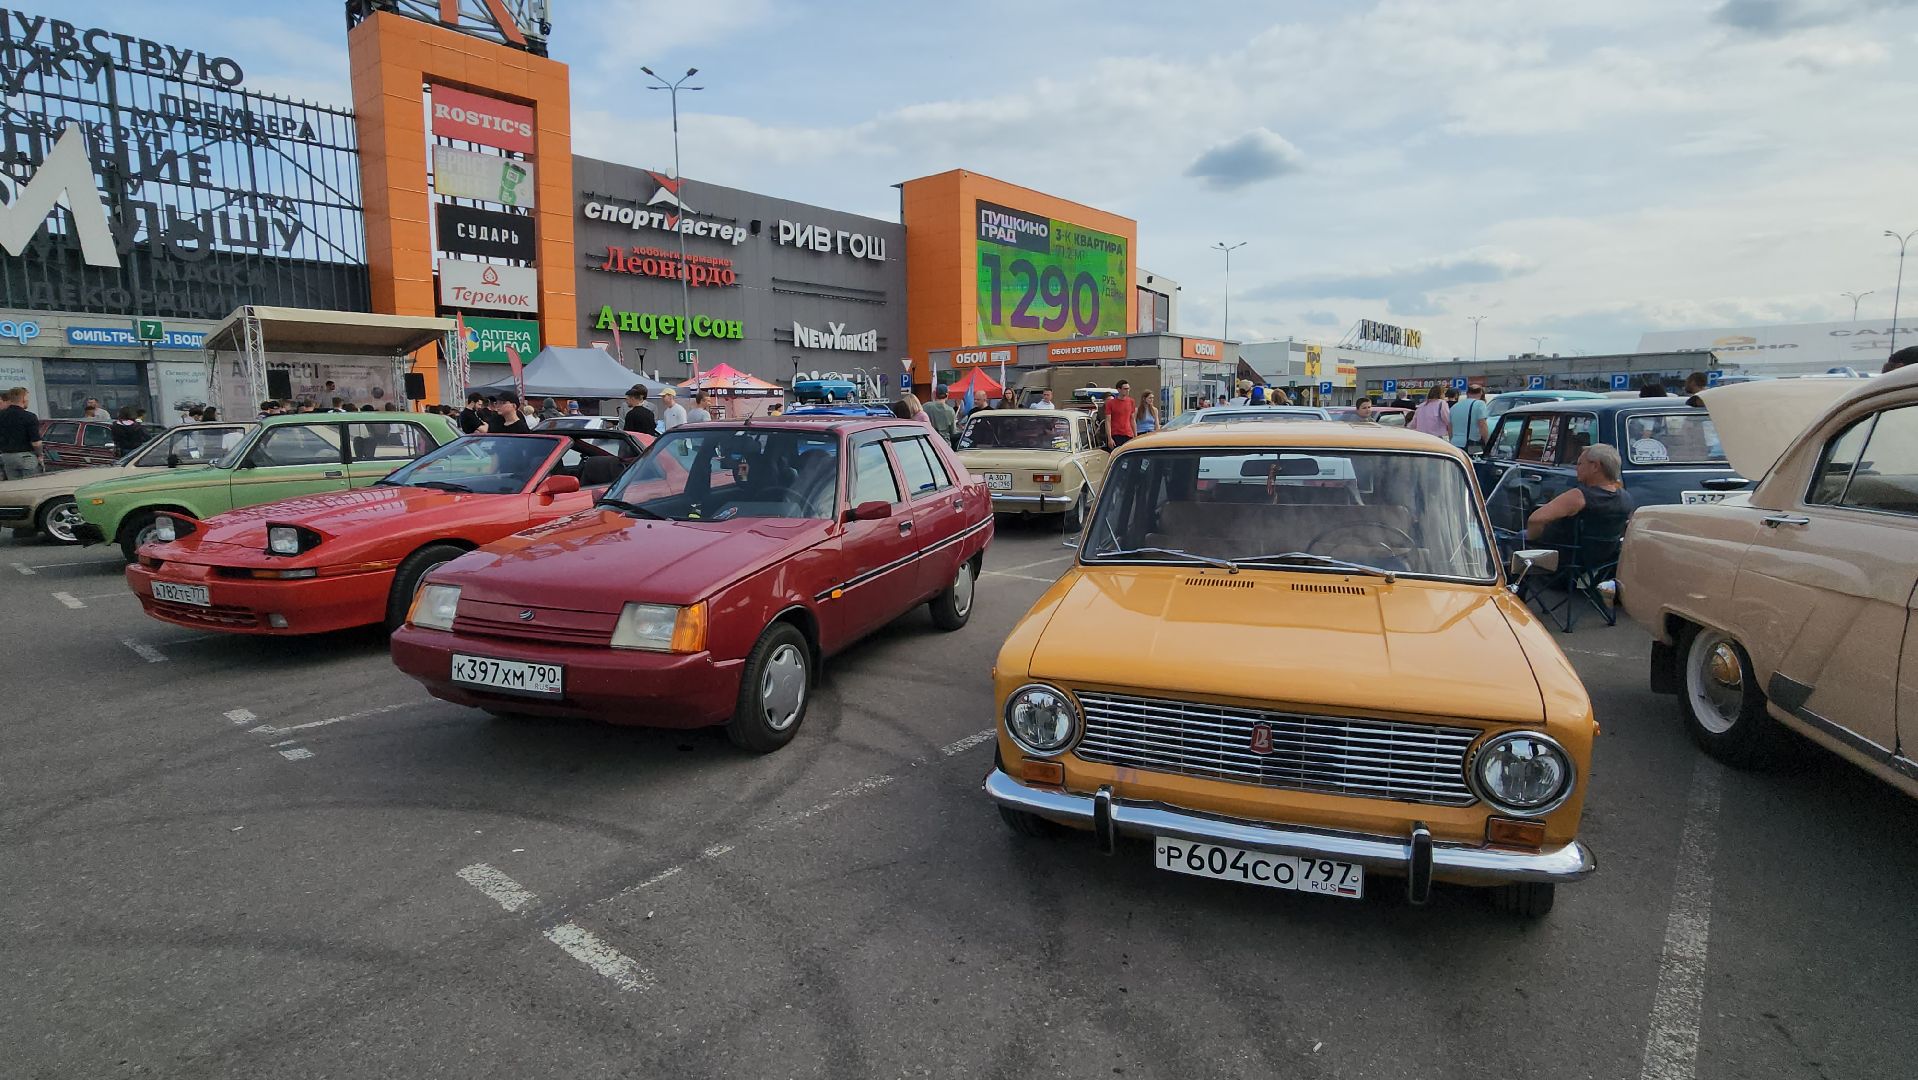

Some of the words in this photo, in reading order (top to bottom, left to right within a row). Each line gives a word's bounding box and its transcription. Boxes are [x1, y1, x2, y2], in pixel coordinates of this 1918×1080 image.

[159, 93, 316, 140] ПРЕМЬЕРА
[434, 103, 533, 137] ROSTIC'S
[118, 198, 304, 259] ЛЫШУ
[457, 222, 519, 245] СУДАРЬ
[584, 201, 748, 246] спортмастер
[981, 209, 1049, 238] ПУШКИНО
[981, 223, 1017, 244] ГРАД
[779, 219, 832, 253] РИВ
[837, 230, 886, 261] ГОШ
[1073, 233, 1123, 257] КВАРТИРА
[601, 245, 737, 289] Леонардо
[632, 245, 734, 268] хобби-гиермаркет
[451, 286, 530, 308] Теремок
[982, 252, 1100, 336] 1290
[147, 324, 156, 336] 7
[481, 329, 531, 342] АПТЕКА
[956, 351, 987, 364] ОБОИ
[1051, 347, 1071, 356] ОБОИ
[1082, 344, 1122, 353] ГЕРМАНИИ
[1195, 343, 1216, 356] ОБОИ
[456, 658, 525, 687] К397ХМ
[528, 665, 557, 684] 790
[534, 683, 549, 691] RUS
[1166, 844, 1295, 885] Р604СО
[1301, 857, 1352, 885] 797
[1311, 880, 1337, 893] RUS
